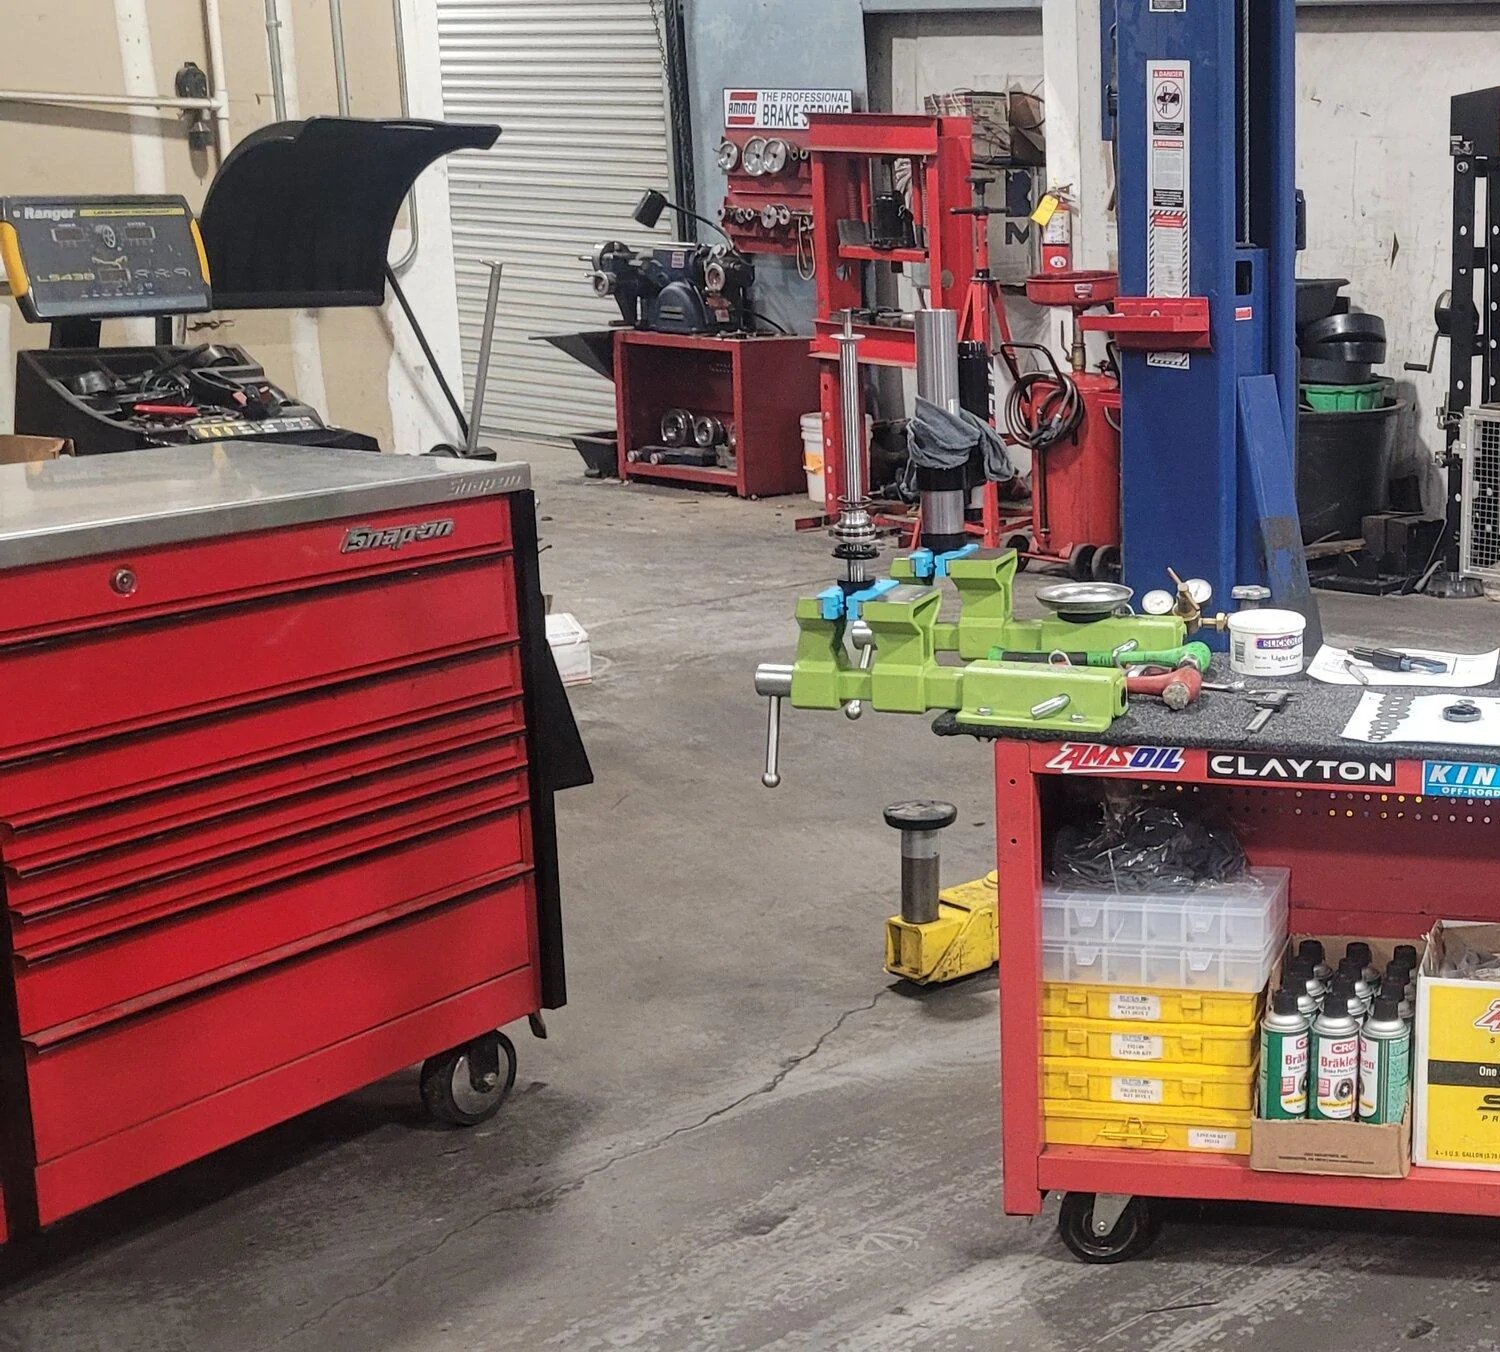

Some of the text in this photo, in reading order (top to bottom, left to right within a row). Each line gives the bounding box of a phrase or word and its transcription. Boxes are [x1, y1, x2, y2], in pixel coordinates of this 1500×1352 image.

[762, 92, 849, 103] THE PROFESSIONAL
[728, 102, 757, 115] AMMCO
[763, 104, 799, 127] BRAKE
[24, 206, 76, 221] Ranger
[341, 519, 454, 554] Snap-on
[1050, 744, 1184, 771] AMSOIL
[1211, 755, 1393, 782] CLAYTON
[1334, 1041, 1356, 1053] CRC
[1479, 1066, 1497, 1077] One
[1462, 1151, 1484, 1159] GALLON
